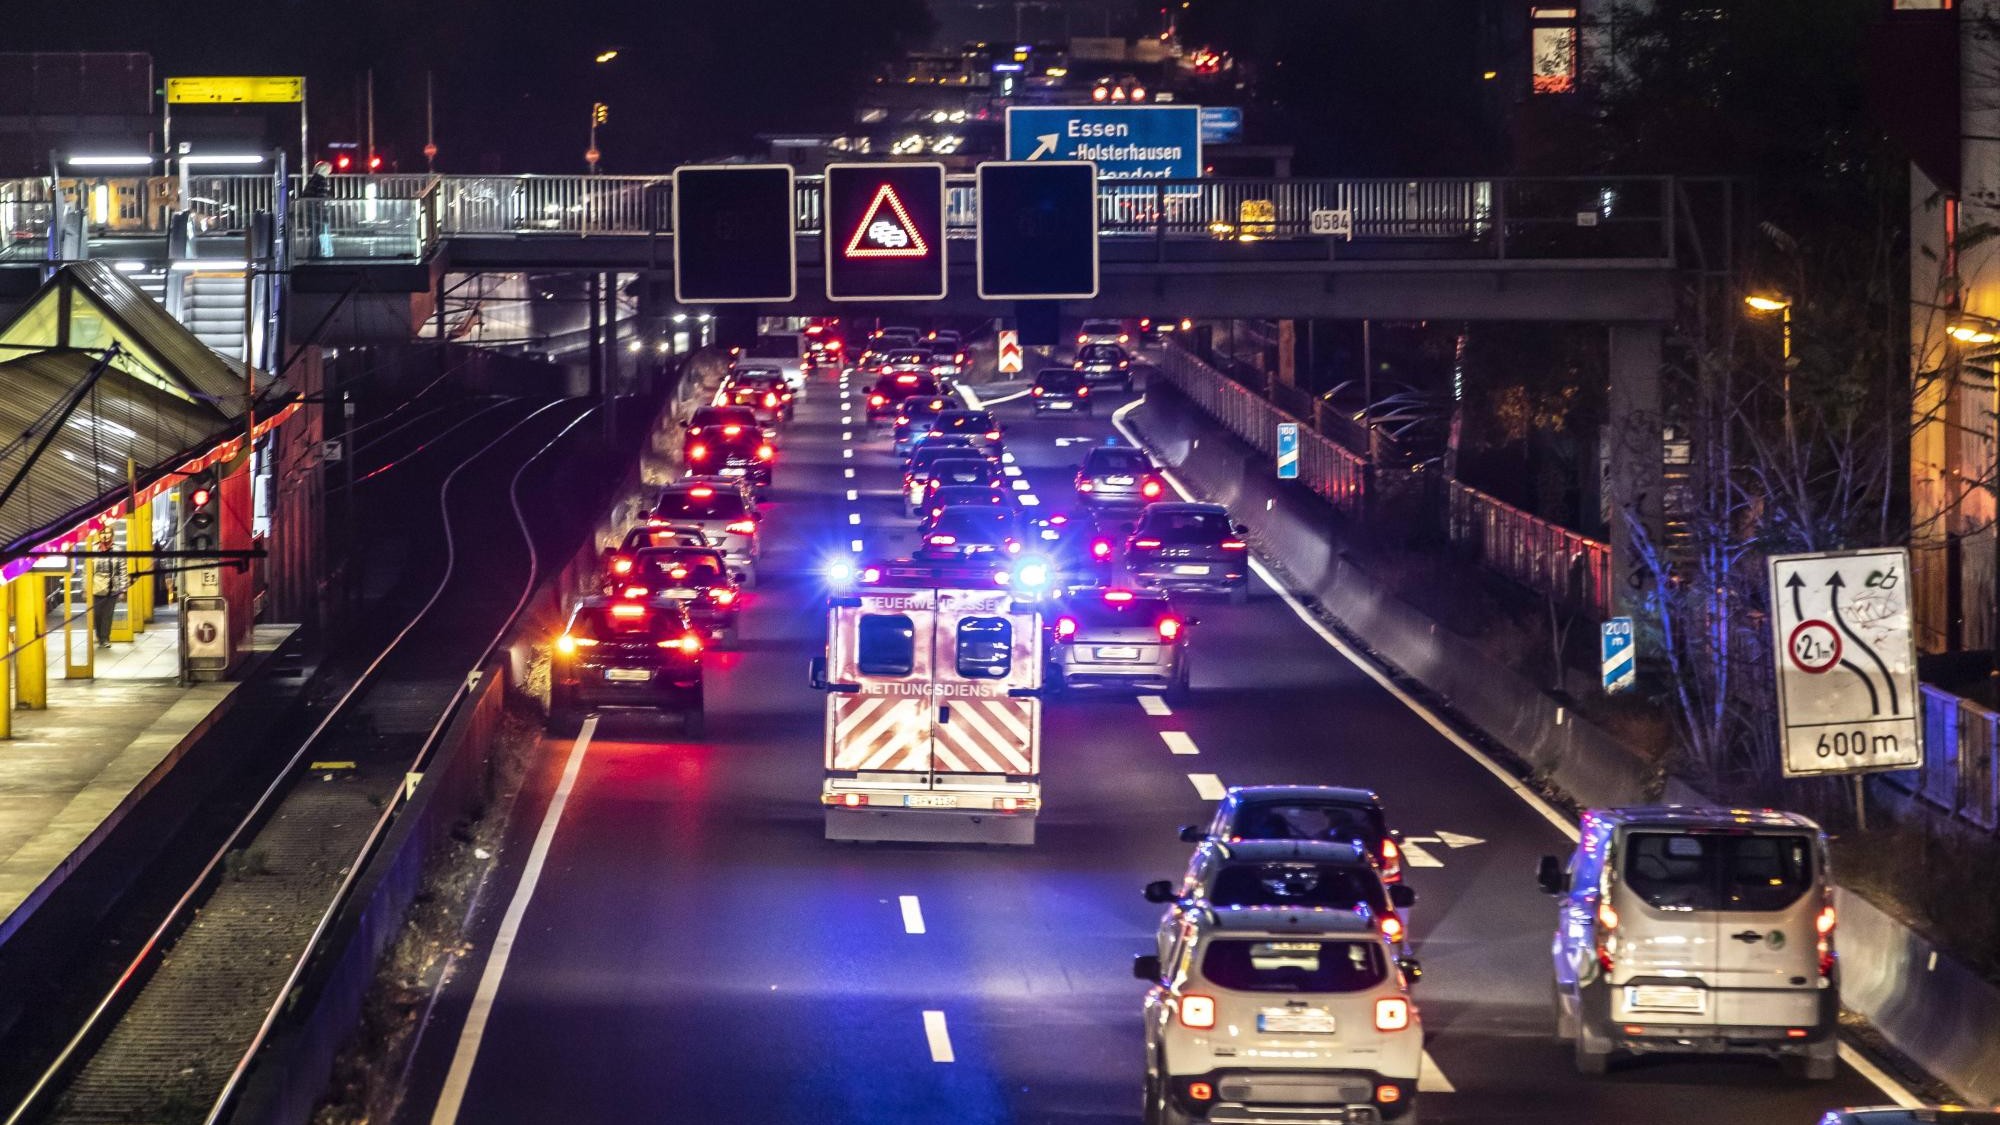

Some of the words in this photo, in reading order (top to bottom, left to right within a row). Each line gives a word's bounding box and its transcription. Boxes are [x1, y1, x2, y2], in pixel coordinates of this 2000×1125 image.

[1067, 119, 1129, 137] Essen
[1068, 143, 1182, 161] -Holsterhausen
[1314, 214, 1349, 230] 0584
[1605, 622, 1630, 636] 200
[1611, 637, 1625, 647] m
[861, 683, 998, 698] RETTUNGSDIENST
[1816, 731, 1867, 758] 600
[1872, 733, 1899, 755] m
